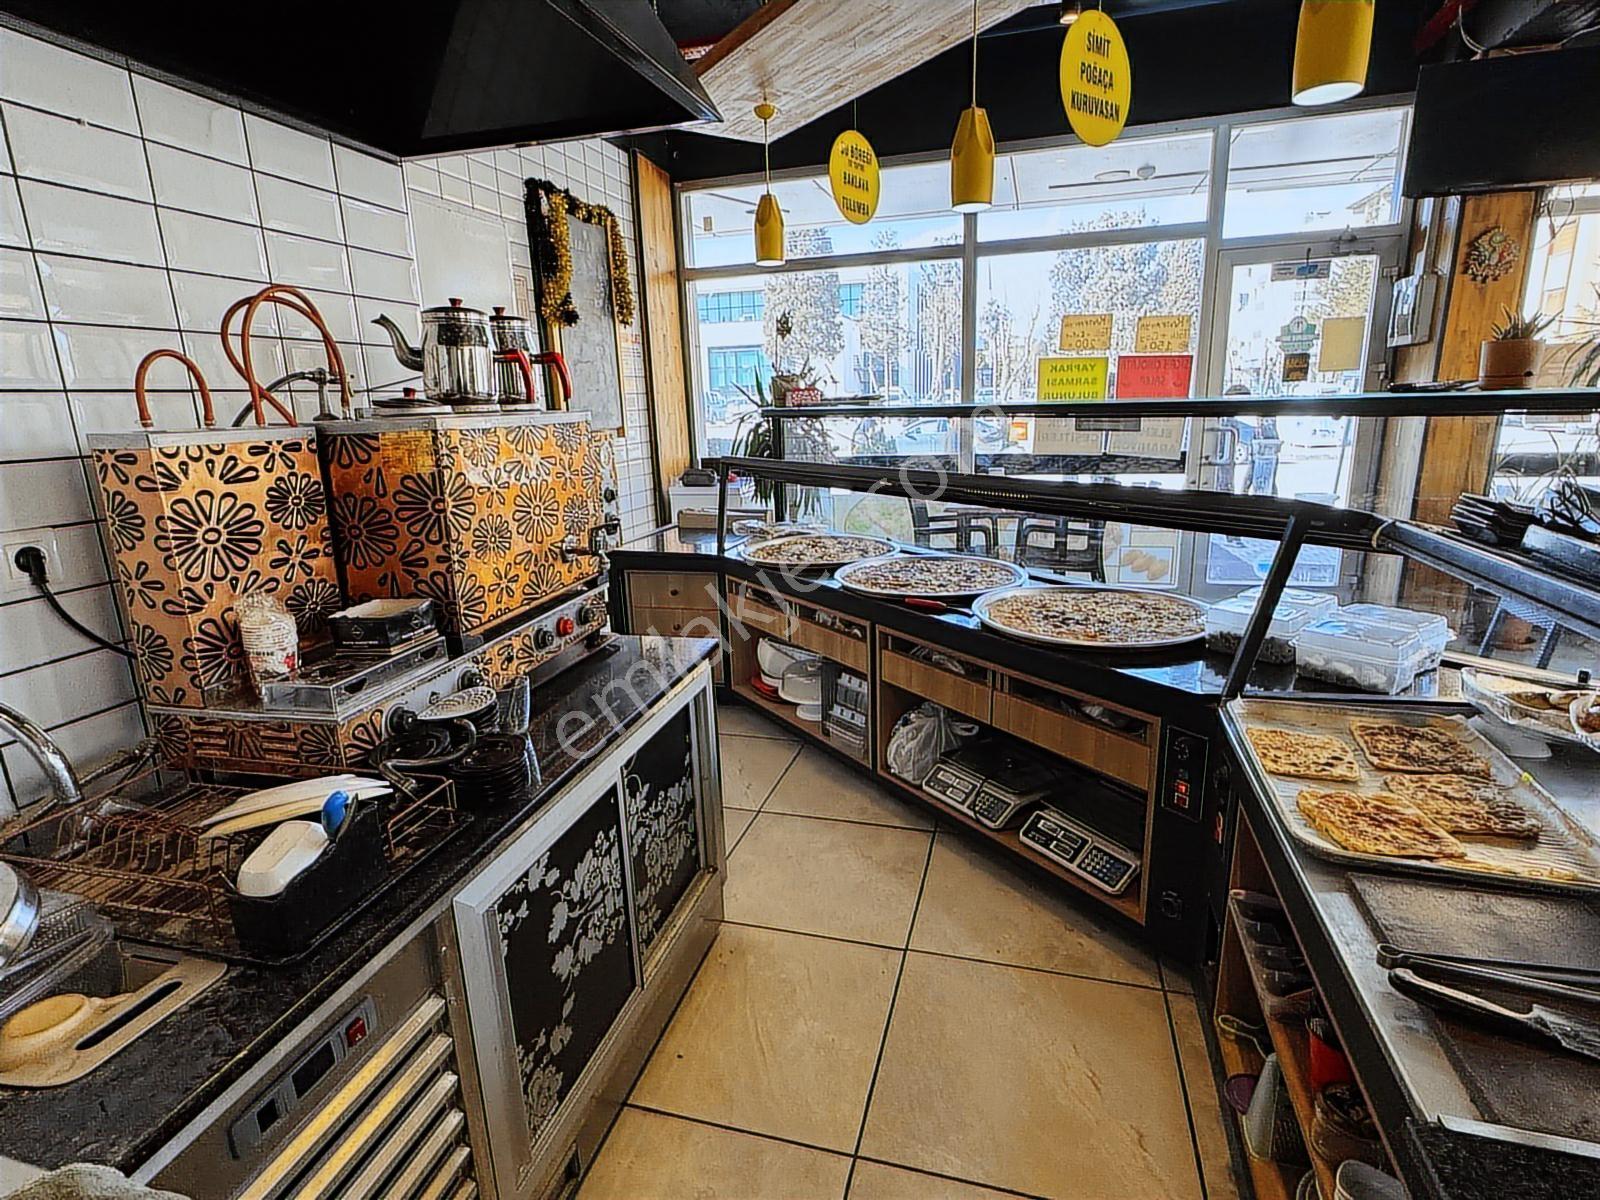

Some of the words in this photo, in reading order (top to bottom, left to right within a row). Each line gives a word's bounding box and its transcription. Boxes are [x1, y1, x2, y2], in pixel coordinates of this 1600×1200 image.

[1086, 28, 1111, 59] SİMİT
[1080, 61, 1114, 94] POĞAÇA
[1070, 89, 1120, 123] KURUVASAN
[843, 170, 869, 192] BAKLAVA
